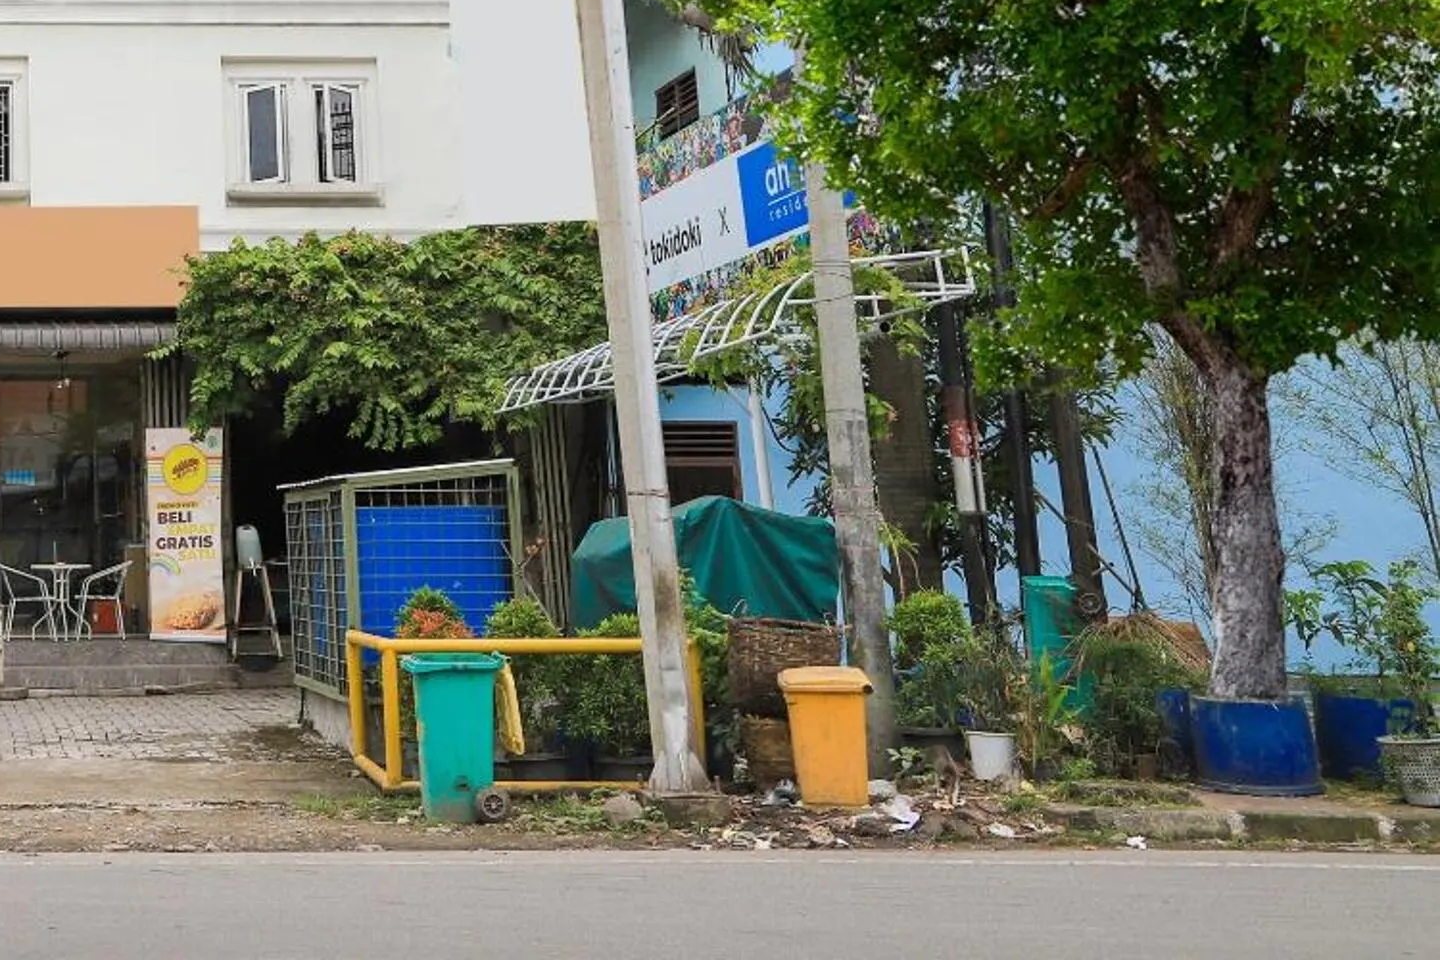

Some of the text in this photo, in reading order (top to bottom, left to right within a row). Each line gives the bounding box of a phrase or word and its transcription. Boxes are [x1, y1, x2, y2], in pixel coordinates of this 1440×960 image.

[650, 216, 702, 265] tokidoki
[157, 511, 192, 525] BELI
[156, 535, 213, 550] GRATIS
